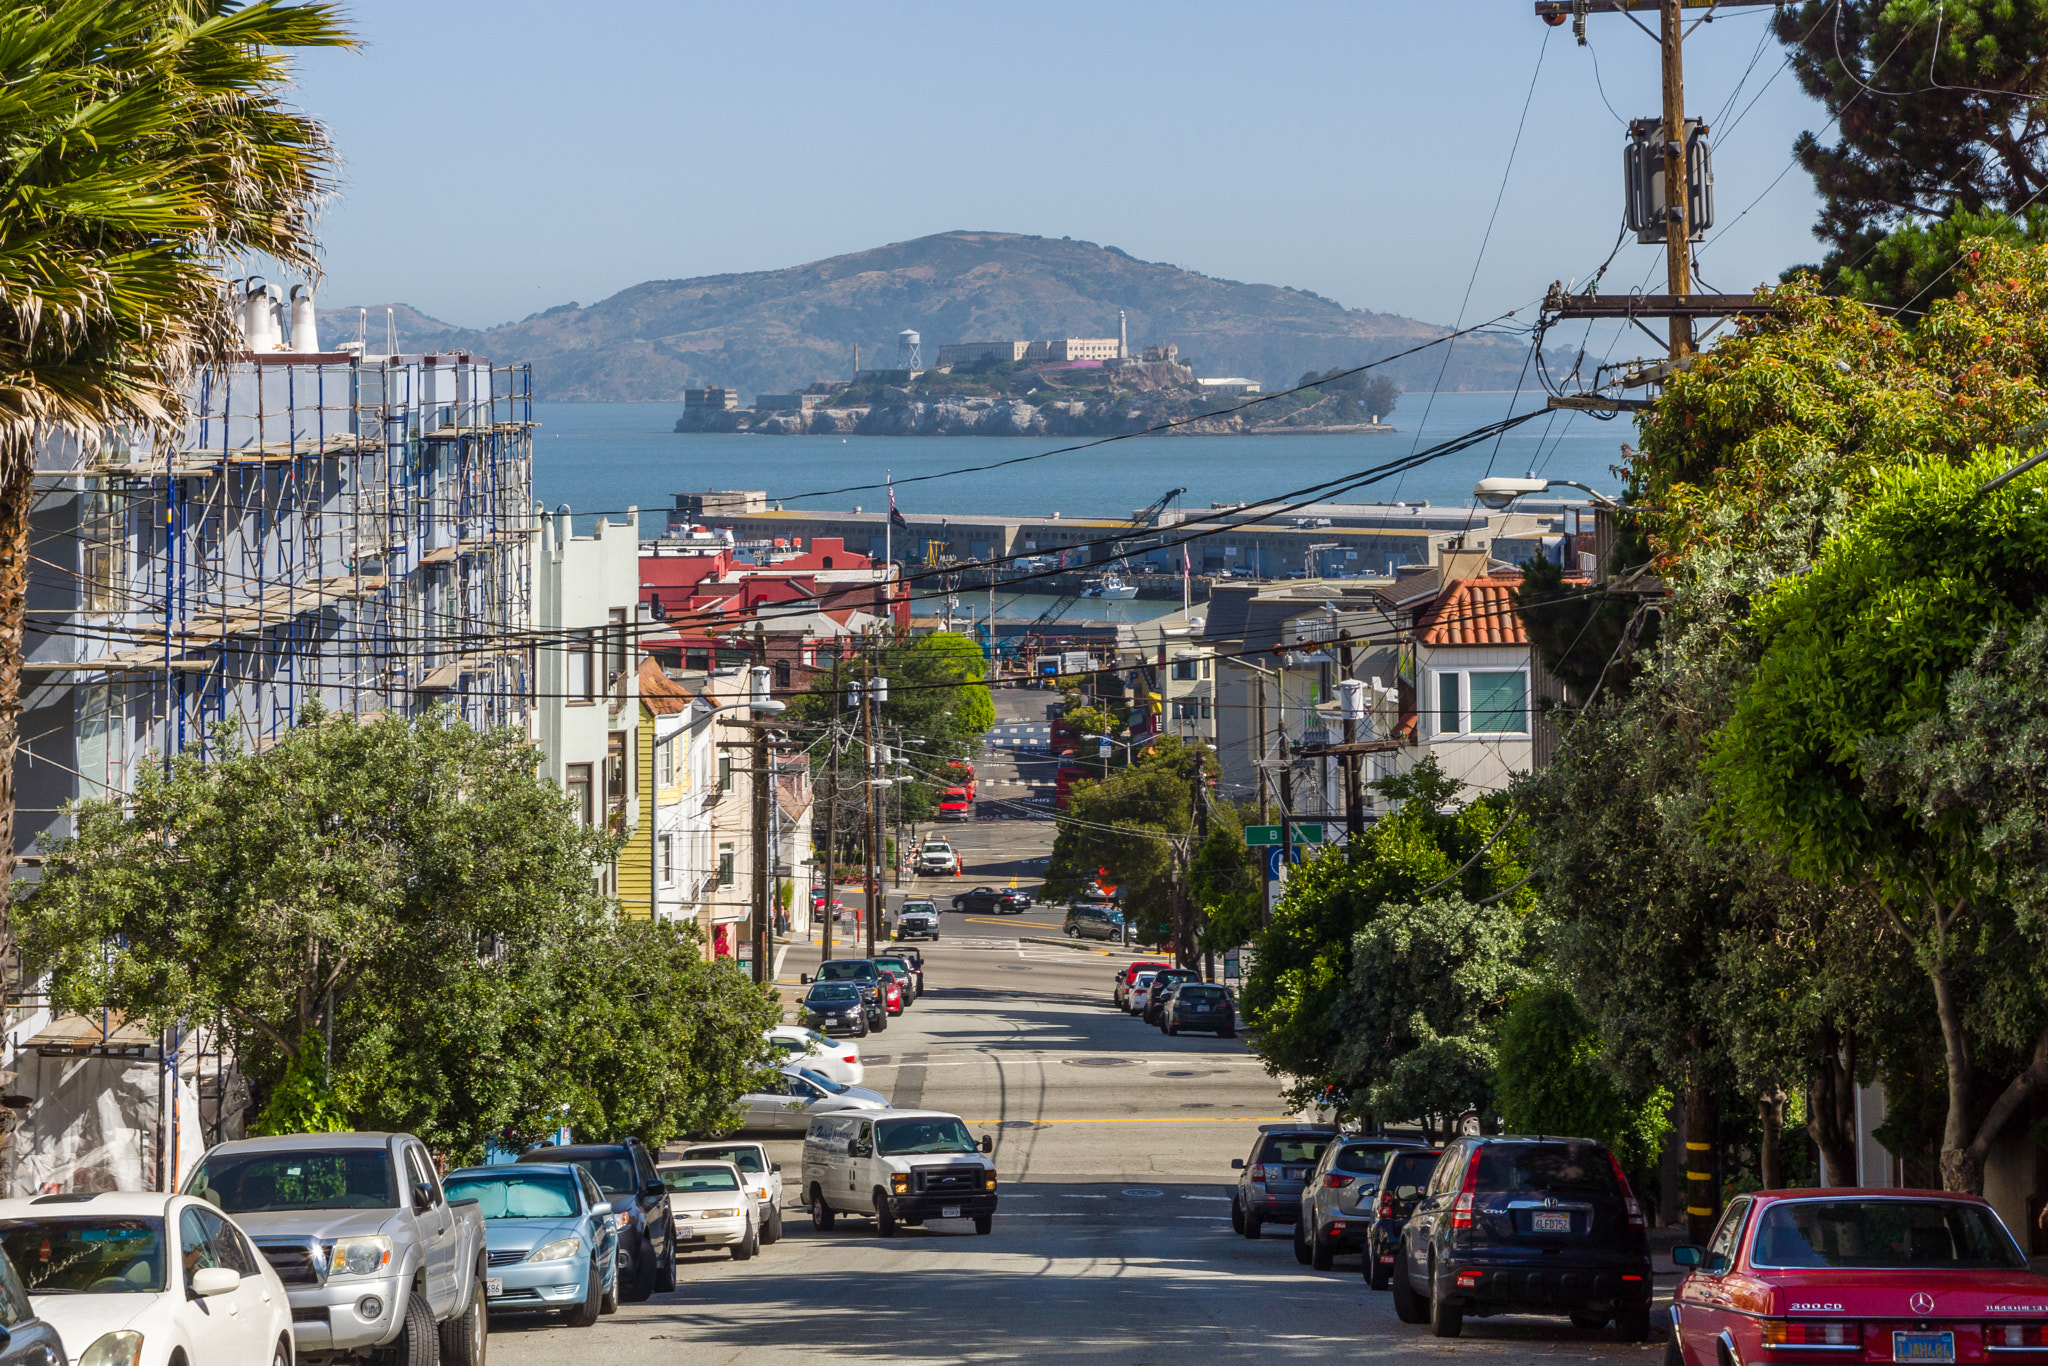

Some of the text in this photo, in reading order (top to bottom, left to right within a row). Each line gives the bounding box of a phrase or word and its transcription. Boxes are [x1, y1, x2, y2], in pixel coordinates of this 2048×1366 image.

[1269, 830, 1299, 842] By
[1535, 1219, 1568, 1230] 6LFD752
[1898, 1343, 1951, 1358] 1JAH484
